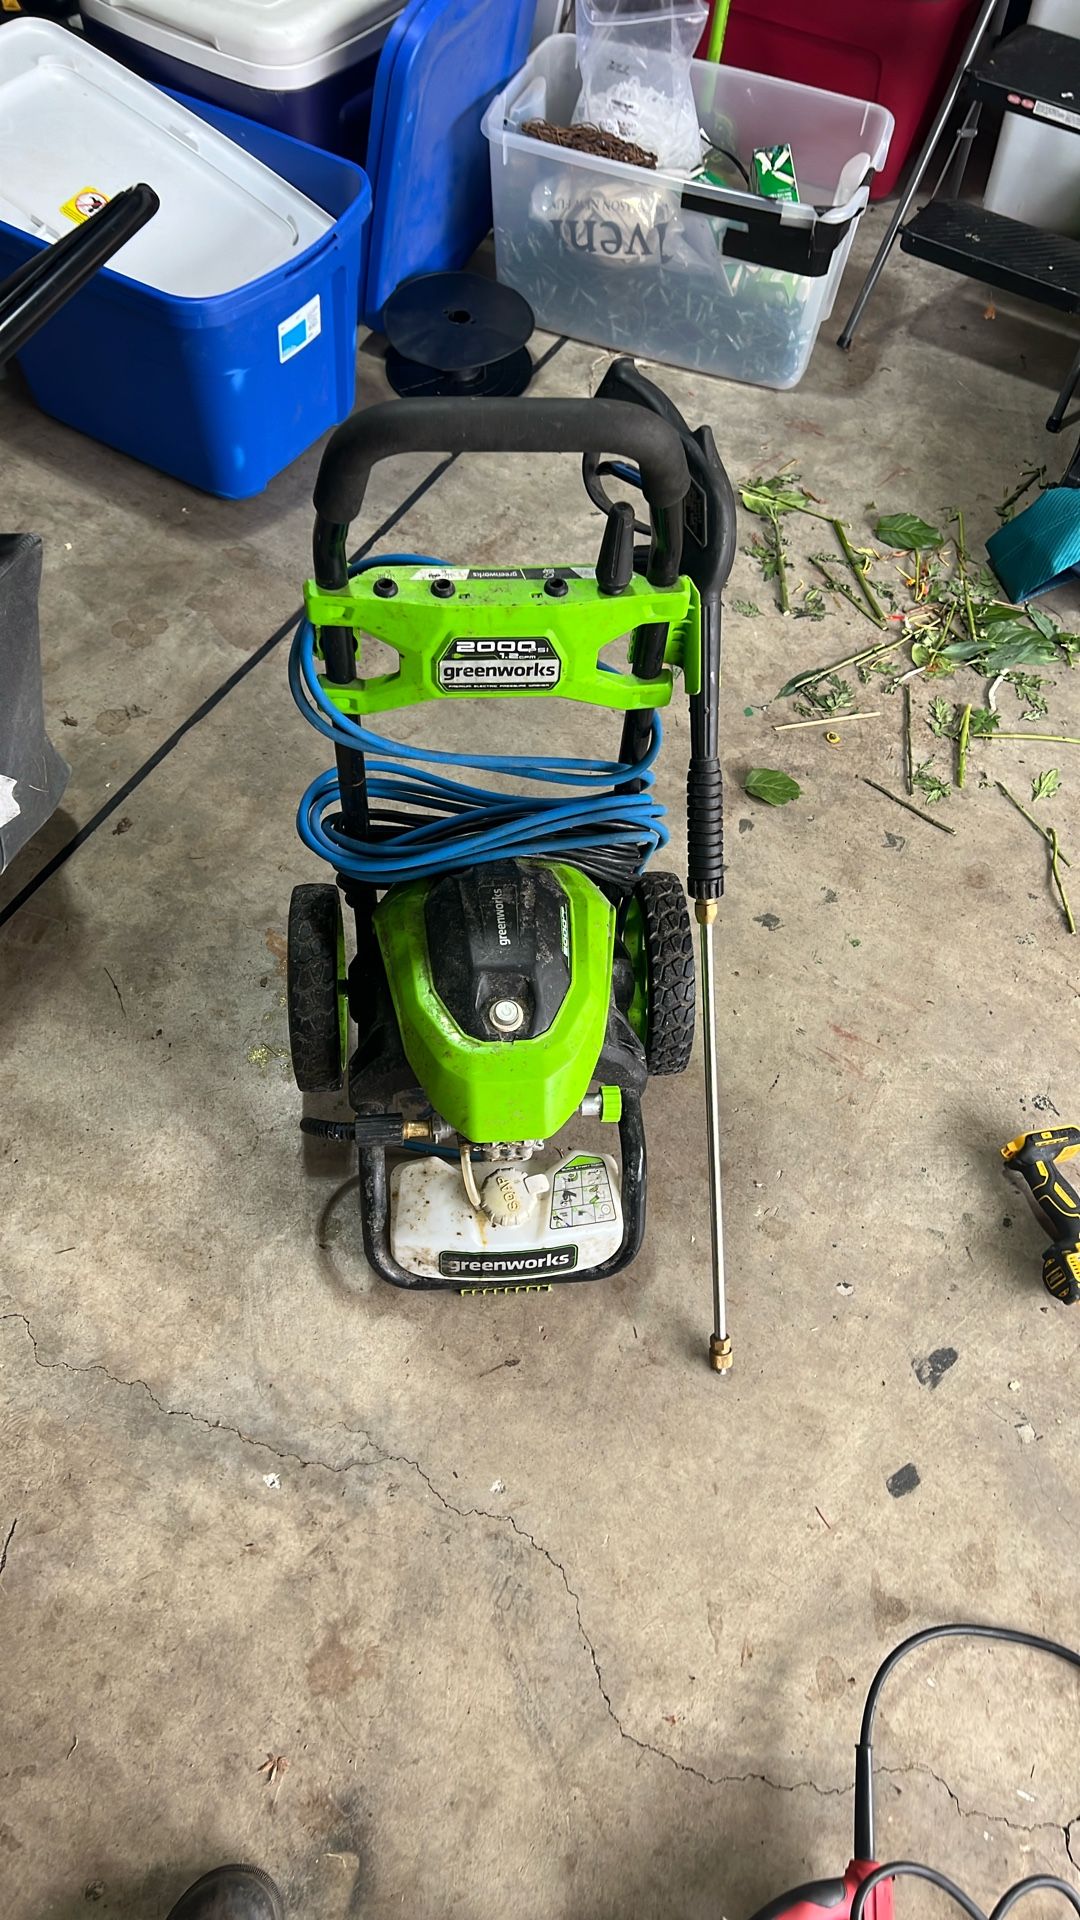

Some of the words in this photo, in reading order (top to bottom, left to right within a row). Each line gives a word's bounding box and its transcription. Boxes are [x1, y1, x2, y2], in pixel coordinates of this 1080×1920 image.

[456, 641, 536, 652] 2000
[443, 663, 555, 681] greenworks
[492, 888, 511, 946] greenworks
[496, 1175, 520, 1212] SOAP
[448, 1253, 570, 1273] greenworks
